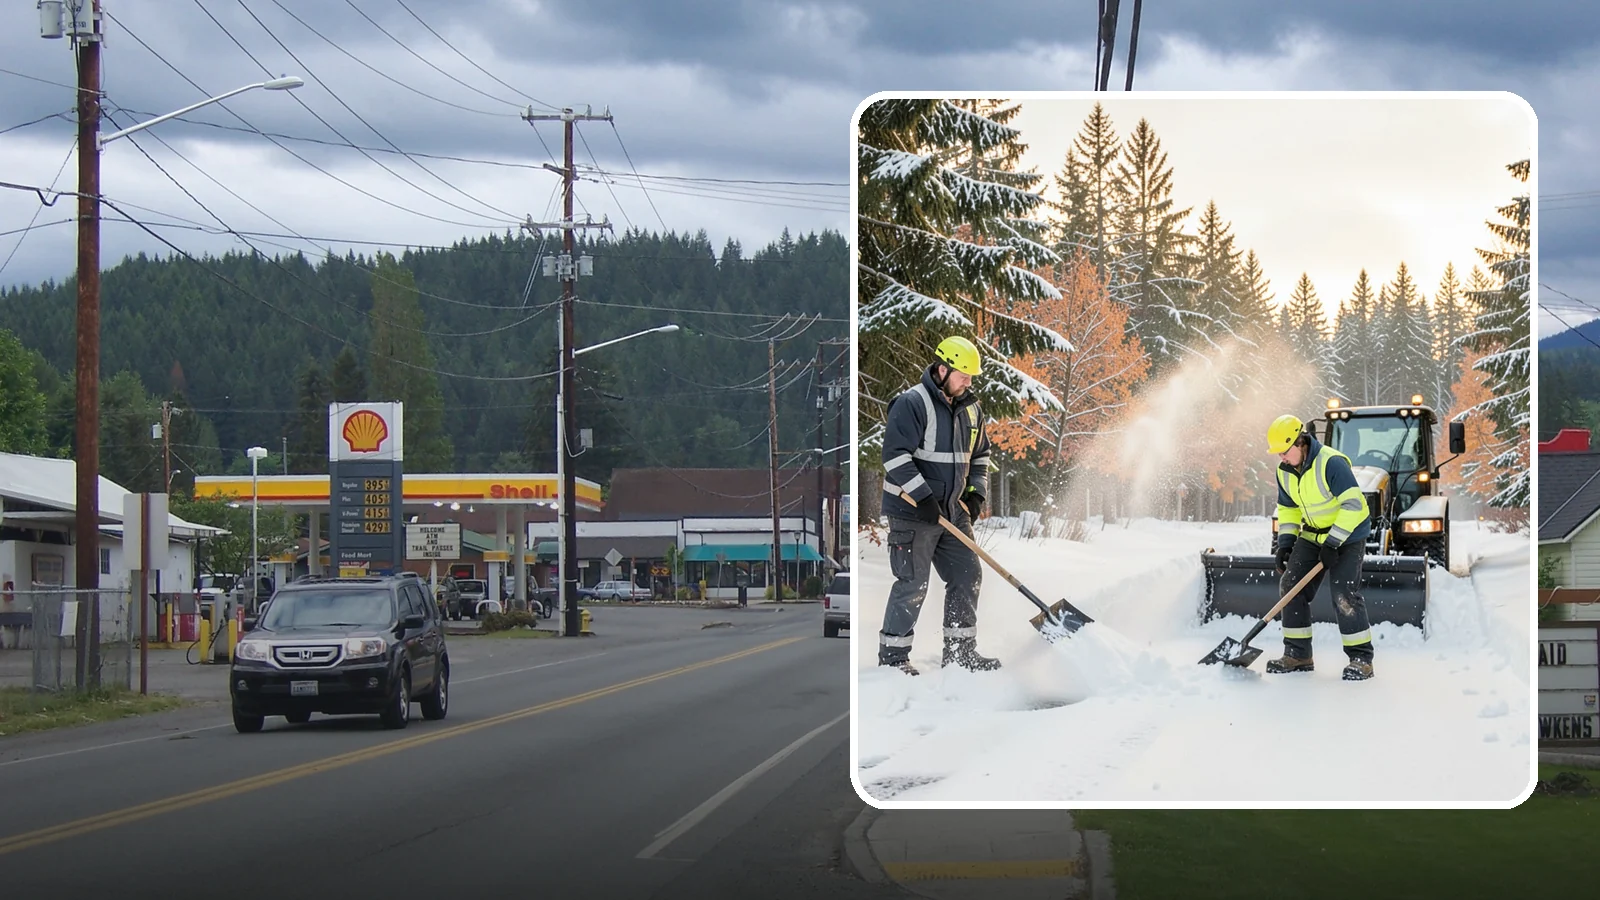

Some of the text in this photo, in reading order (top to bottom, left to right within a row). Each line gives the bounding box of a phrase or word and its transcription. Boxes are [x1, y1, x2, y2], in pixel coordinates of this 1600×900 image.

[366, 480, 383, 490] 395
[490, 484, 547, 498] Shell
[366, 494, 383, 504] 405
[366, 508, 383, 518] 415
[366, 522, 383, 532] 429
